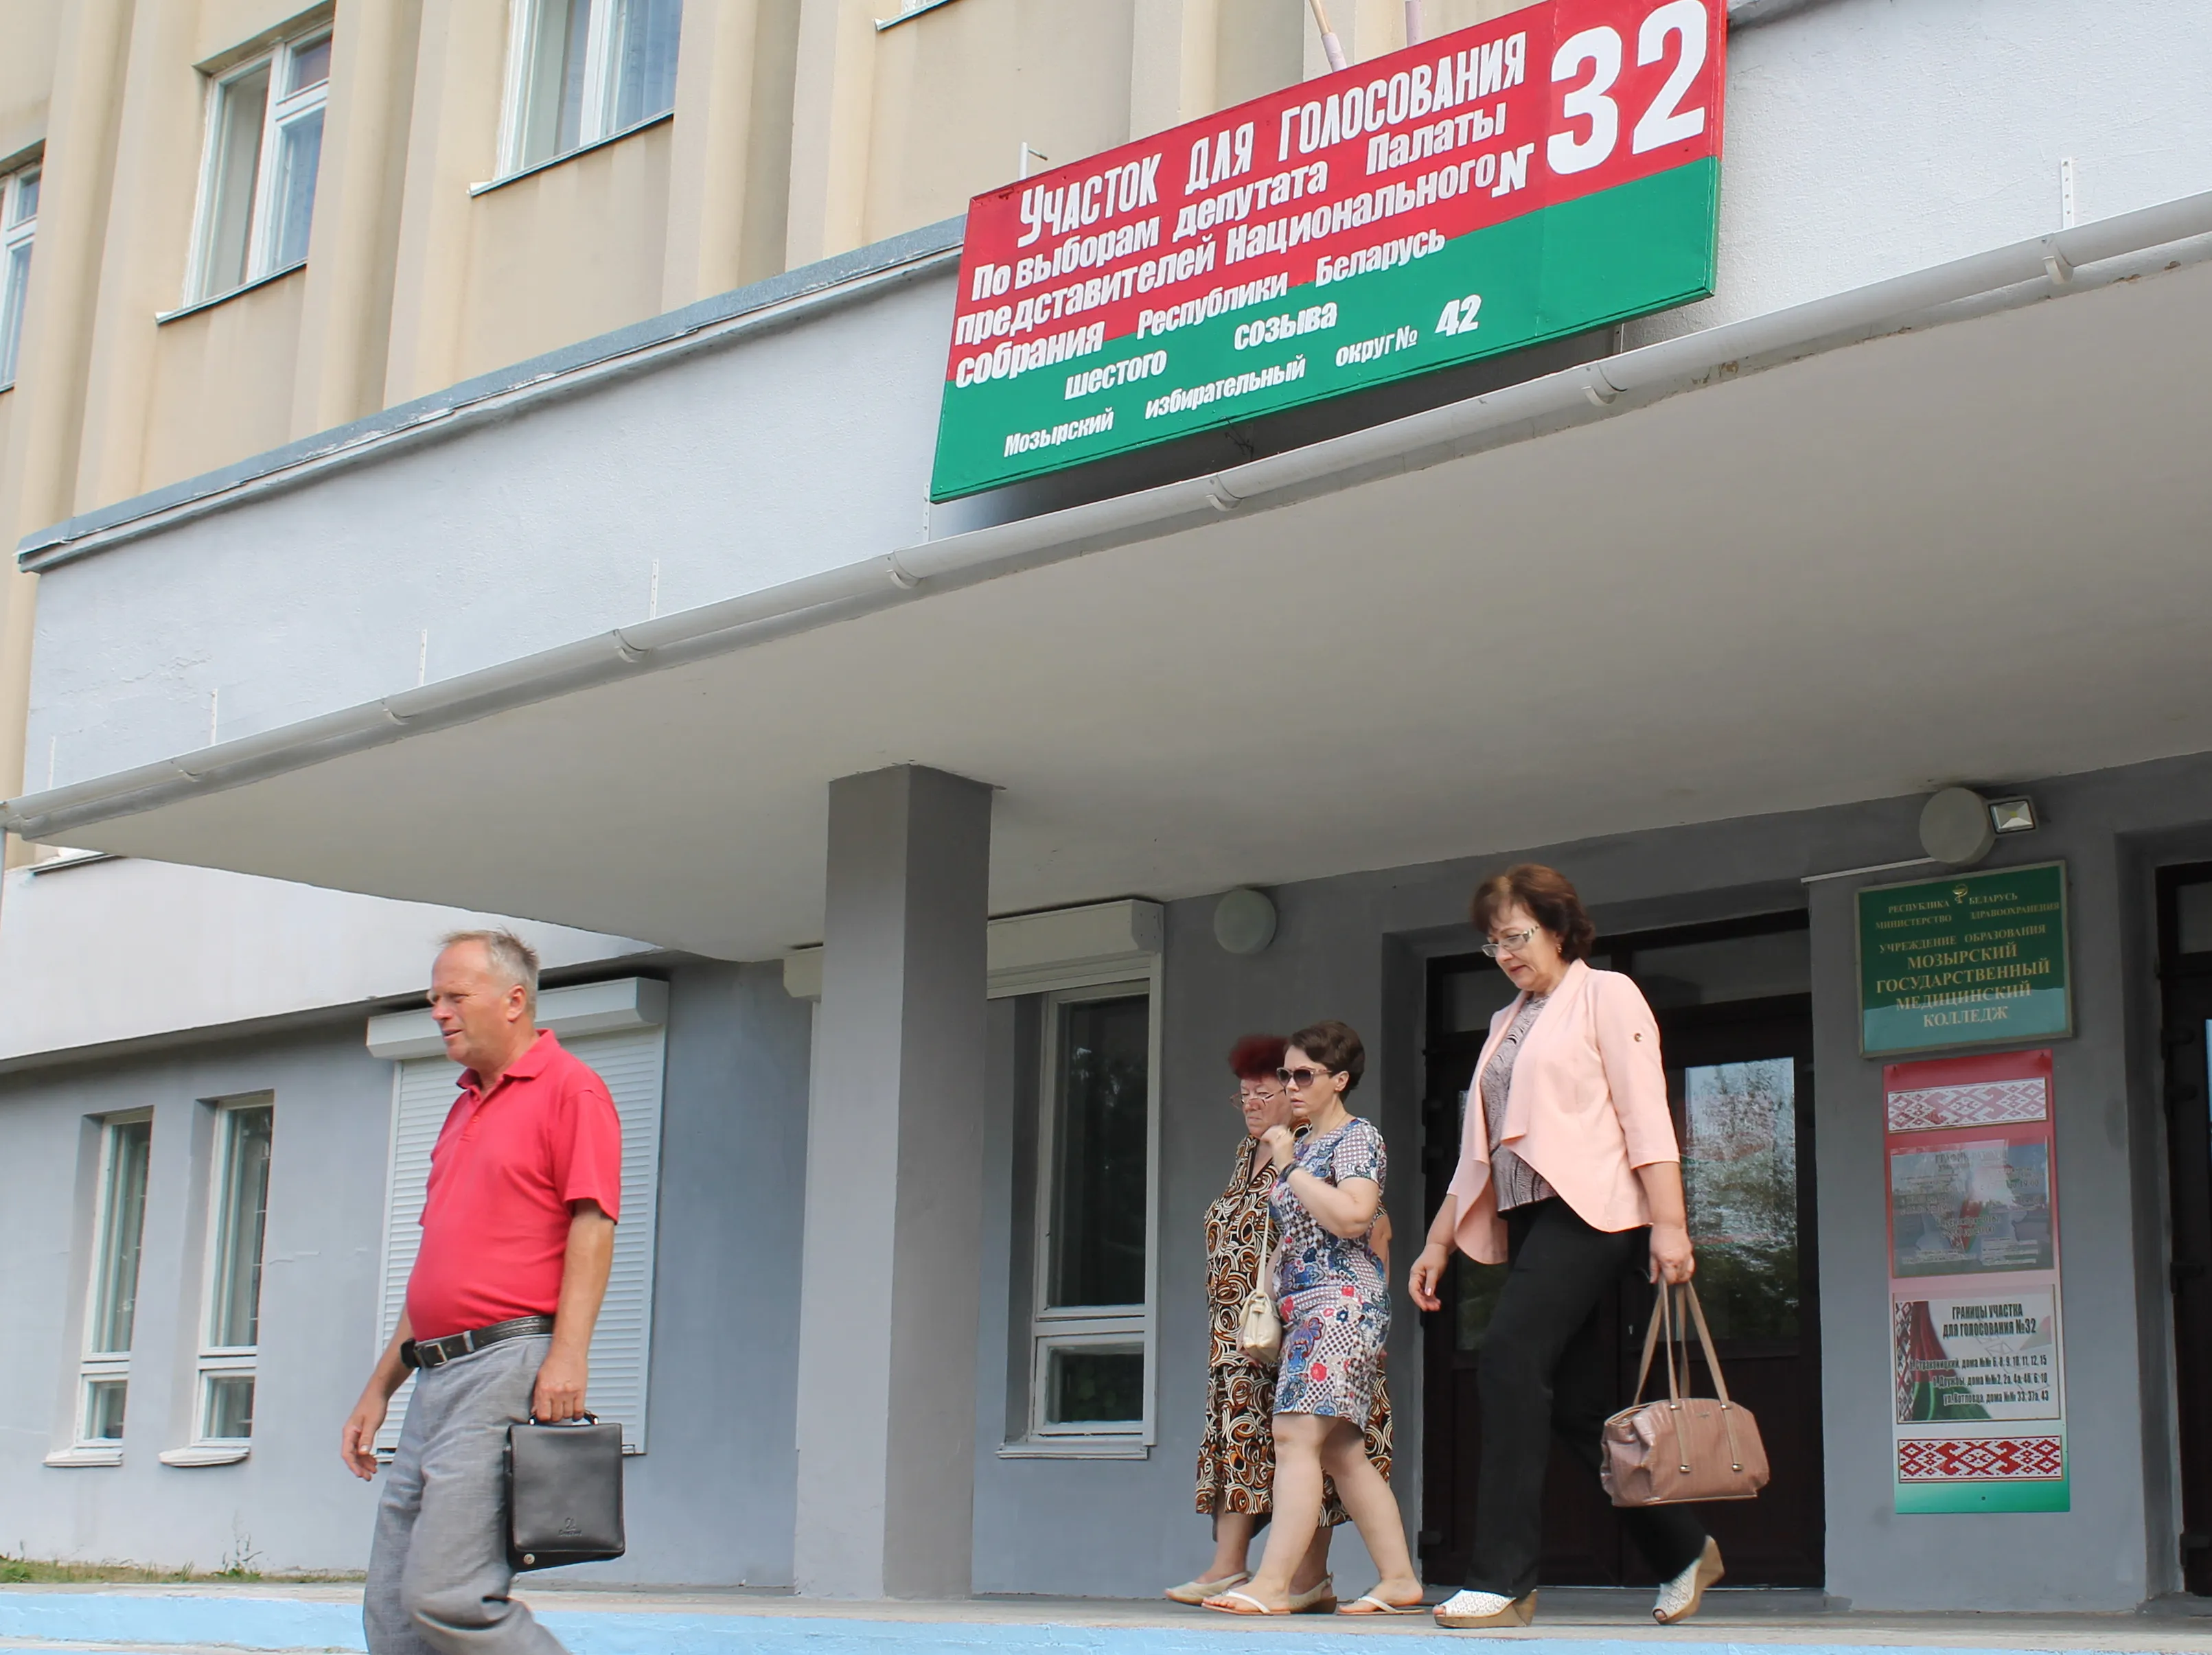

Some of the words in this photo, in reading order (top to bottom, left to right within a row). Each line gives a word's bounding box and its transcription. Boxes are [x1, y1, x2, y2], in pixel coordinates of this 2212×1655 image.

[1546, 0, 1708, 175] 32
[1017, 152, 1162, 248] УЧАСТОК
[1184, 121, 1255, 196] ДЛЯ
[1278, 31, 1527, 162] ГОЛОСОВАНИЯ
[1172, 160, 1328, 243] депутата
[1366, 102, 1507, 176] Палаты
[954, 233, 1217, 346] представителей
[1224, 152, 1495, 266] Национального
[955, 320, 1106, 389] собрания
[1136, 271, 1289, 340] Республики
[1315, 228, 1446, 288] Беларусь
[1063, 349, 1168, 401] шестого
[1234, 301, 1338, 351] созыва
[1003, 406, 1115, 458] Мозырский
[1144, 354, 1306, 419] избирательный
[1434, 293, 1482, 338] 42
[1876, 914, 1952, 930] МИНИСТЕРСТВО
[1970, 901, 2060, 921] ЗДРАВООХРАНЕНИЯ
[1888, 900, 1950, 914] РЕСПУБЛИКА
[1968, 892, 2018, 905] БЕЛАРУСЬ
[1879, 936, 1957, 953] УЧРЕЖДЕНИЕ
[1964, 924, 2047, 943] ОБРАЗОВАНИЯ
[1907, 941, 2018, 970] МОЗЫРСКИЙ
[1876, 957, 2051, 994] ГОСУДАРСТВЕННЫЙ
[1896, 980, 2032, 1011] МЕДИЦИНСКИЙ
[1923, 1006, 2009, 1028] КОЛЛЕДЖ
[1952, 1304, 1988, 1320] ГРАНИЦЫ
[1988, 1303, 2023, 1318] УЧАСТКА
[1942, 1323, 1959, 1339] ДЛЯ
[1959, 1321, 2014, 1337] ГОЛОСОВАНИЯ
